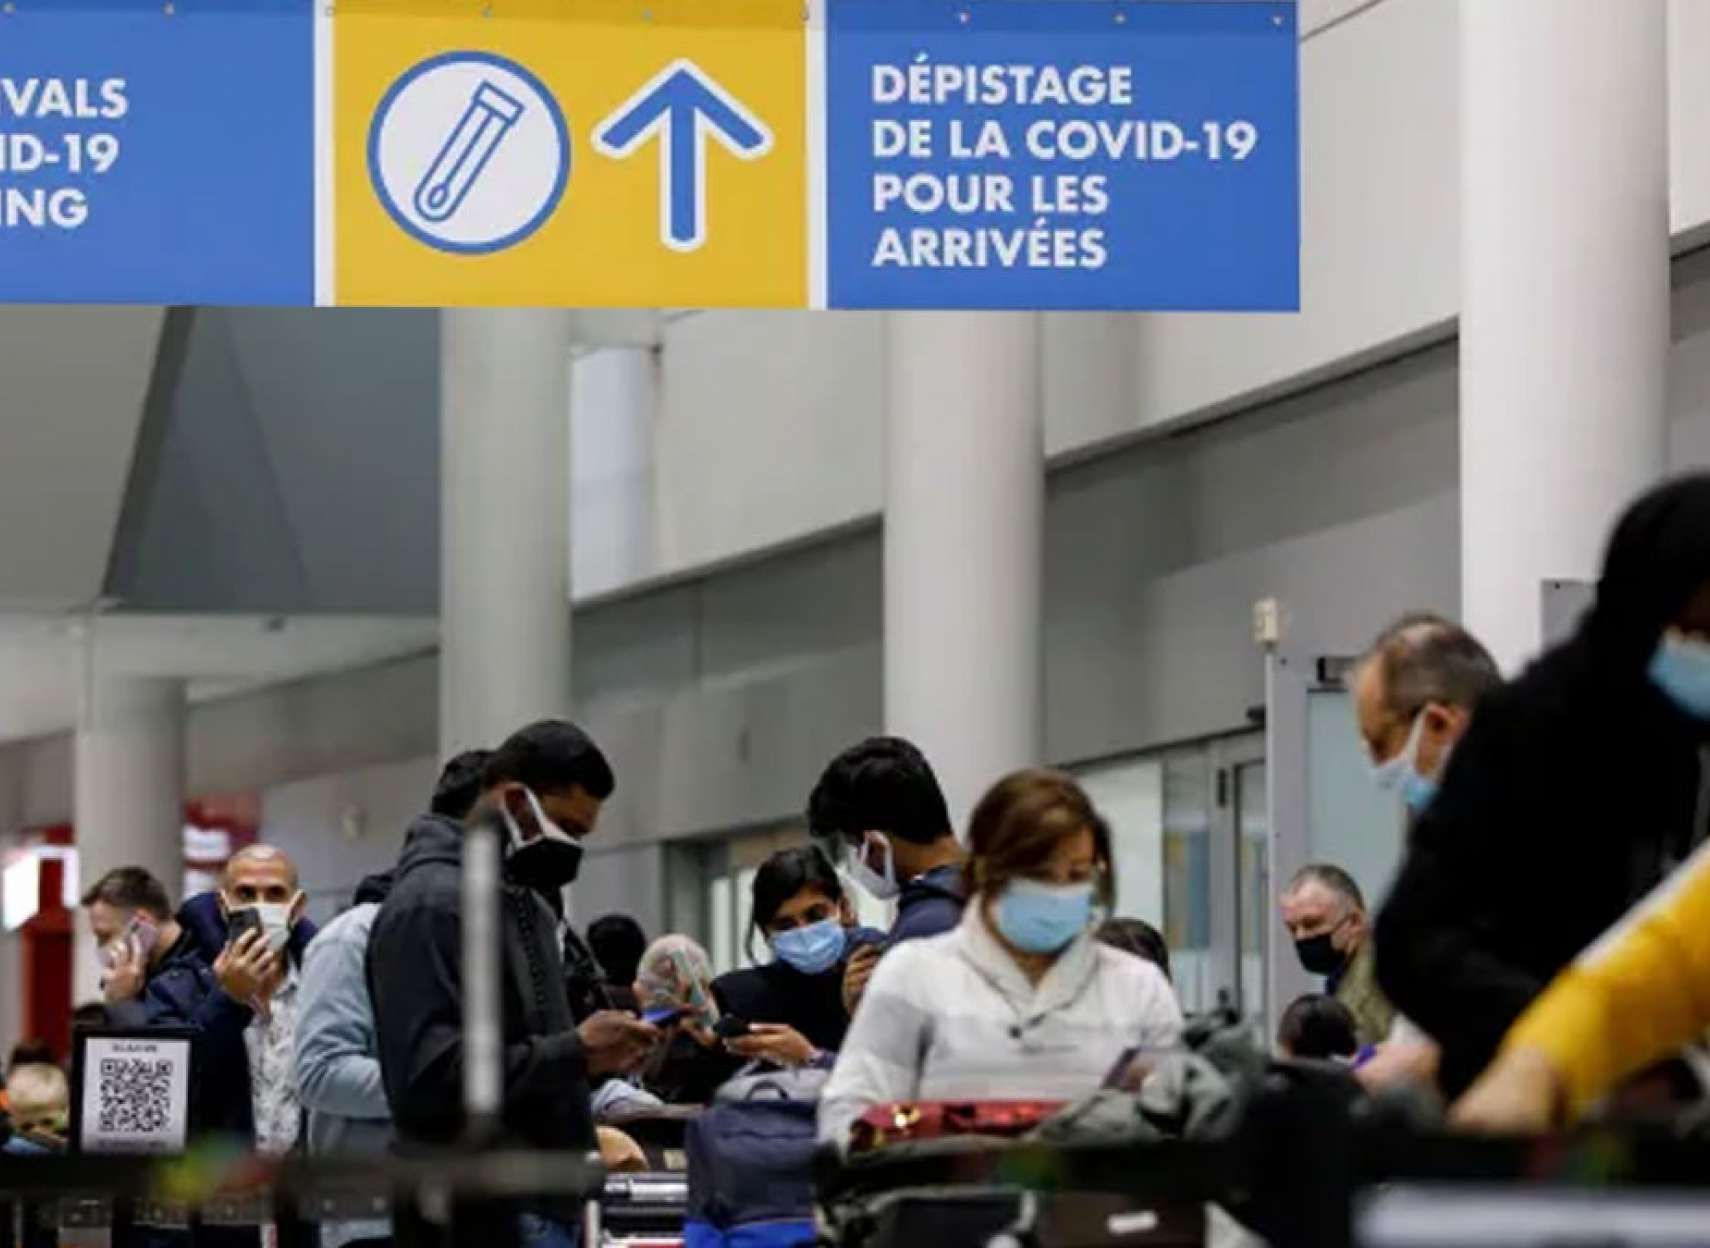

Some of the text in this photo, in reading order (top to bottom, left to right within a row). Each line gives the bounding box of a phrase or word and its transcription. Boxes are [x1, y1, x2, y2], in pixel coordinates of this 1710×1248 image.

[0, 78, 128, 119] VALS
[873, 54, 1132, 105] DÉPISTAGE
[873, 119, 1256, 160] DE LA COVID-19
[0, 187, 89, 228] NG
[873, 173, 1108, 214] POUR LES
[872, 217, 1107, 268] ARRIVÉES
